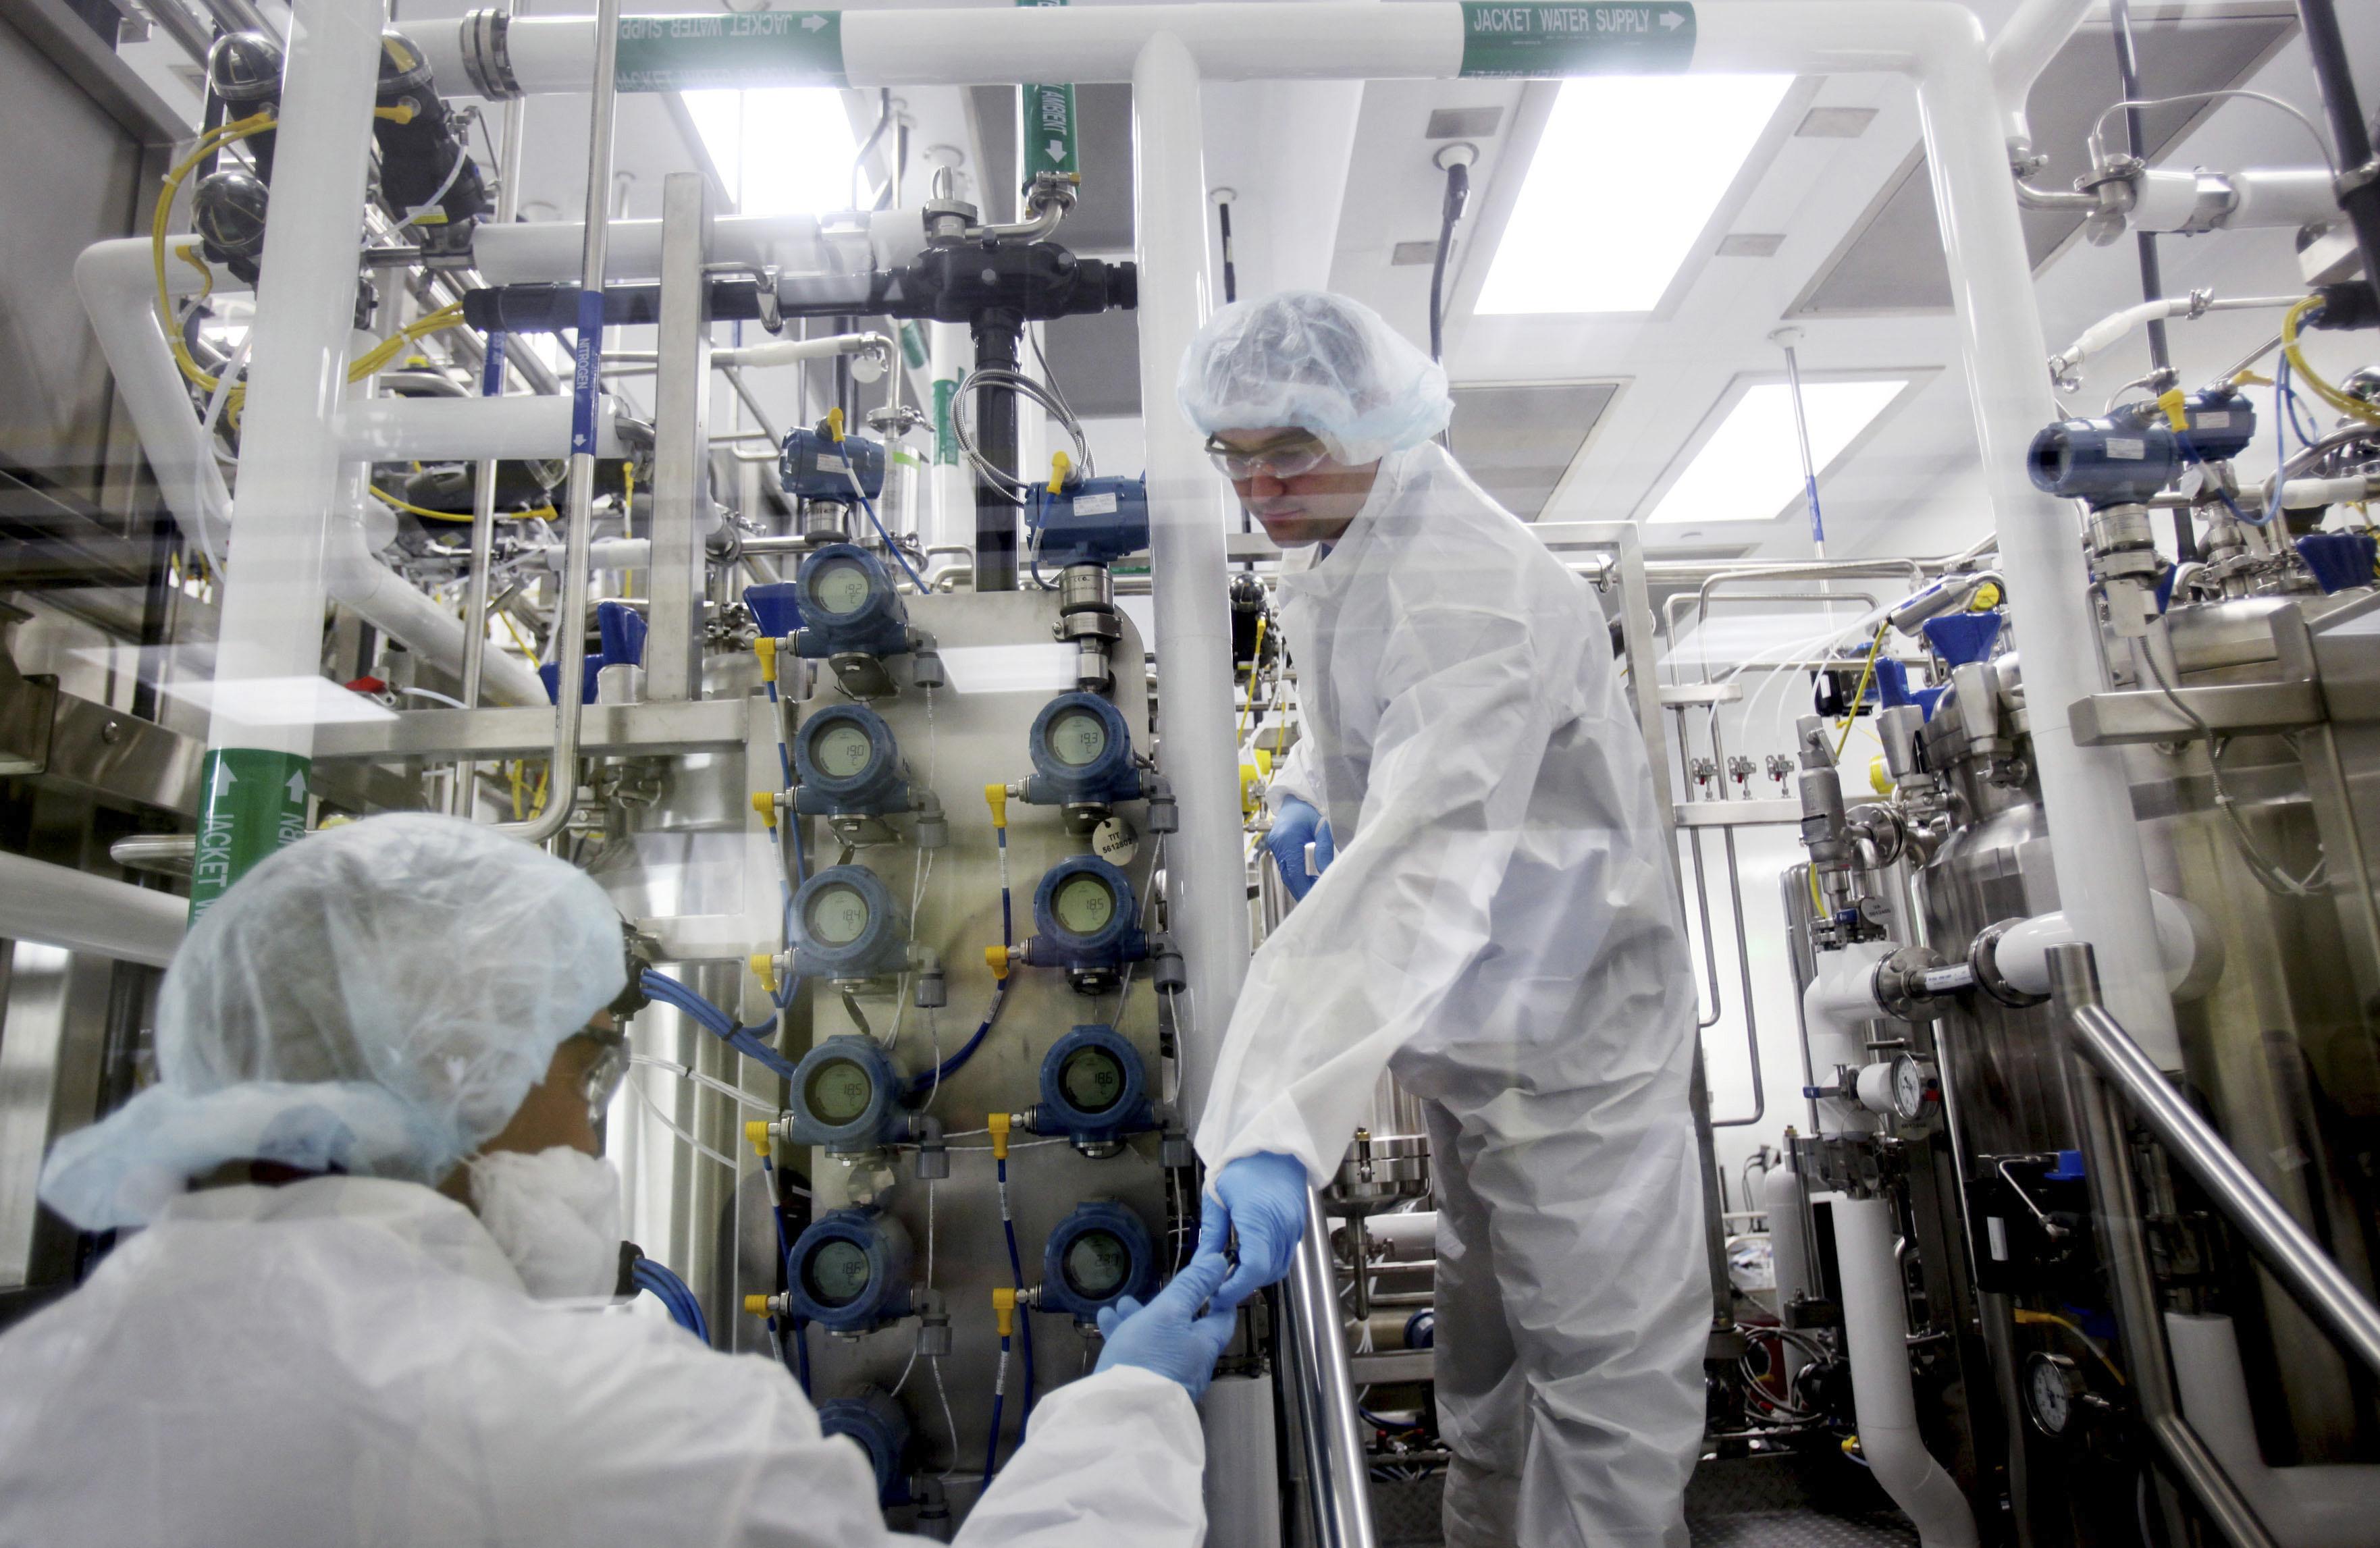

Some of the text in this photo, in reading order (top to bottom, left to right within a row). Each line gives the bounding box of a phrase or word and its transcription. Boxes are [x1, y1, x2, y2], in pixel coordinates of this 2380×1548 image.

[670, 17, 722, 38] WATER
[730, 14, 793, 36] JACKET
[1474, 8, 1649, 32] JACKET WATER SUPPLY
[1042, 90, 1067, 136] AMBIENT
[577, 338, 590, 390] NITROGEN
[1103, 838, 1132, 853] 5612802
[1108, 832, 1119, 841] TIT
[197, 810, 235, 888] JACKET
